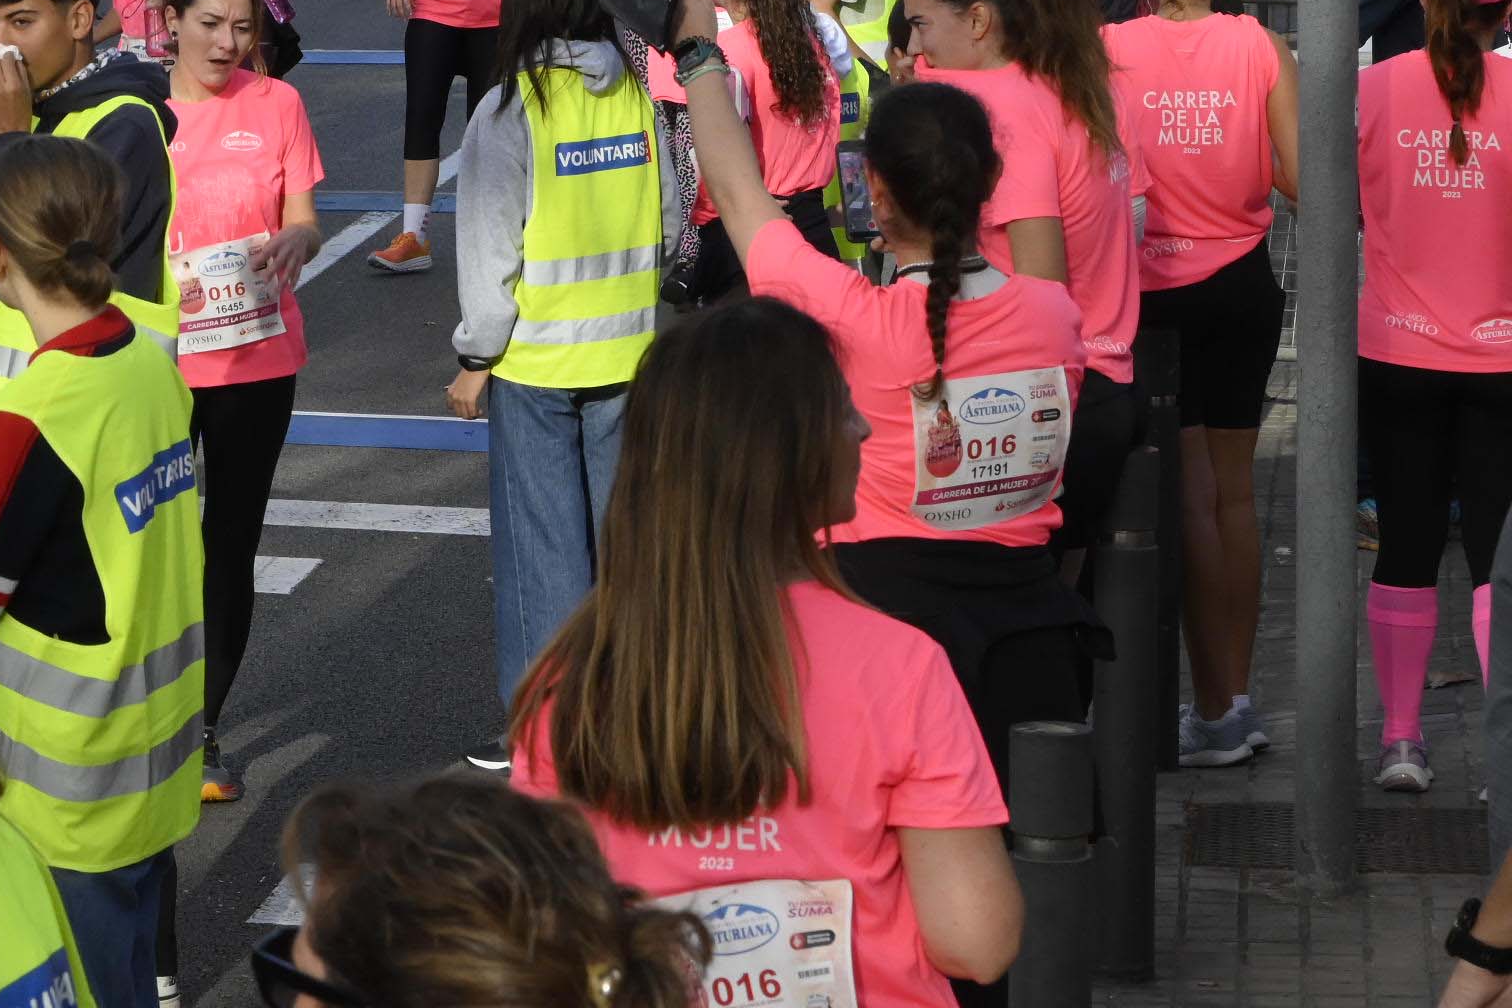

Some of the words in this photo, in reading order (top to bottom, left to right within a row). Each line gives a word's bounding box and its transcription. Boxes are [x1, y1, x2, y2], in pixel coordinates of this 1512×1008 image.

[1143, 90, 1237, 109] CARRERA
[1162, 109, 1186, 126] DE
[1196, 110, 1220, 127] LA
[1158, 128, 1224, 145] MUJER
[558, 141, 645, 167] VOLUNTARIS
[1183, 147, 1201, 155] 2023
[1418, 150, 1445, 168] DE
[1459, 152, 1481, 168] A
[1413, 169, 1485, 189] MUJER
[203, 260, 244, 274] ASTURIANA
[209, 282, 245, 301] 016
[215, 302, 244, 314] 16455
[187, 320, 219, 330] CARRERA
[239, 312, 258, 321] MUJER
[1385, 315, 1438, 335] OYSHO
[187, 334, 222, 345] OYSHO
[1030, 389, 1057, 400] SUMA
[964, 402, 1020, 419] ASTURIANA
[967, 434, 1017, 460] 016
[971, 462, 1008, 478] 17191
[932, 487, 972, 501] CARRERA
[973, 485, 985, 494] DE
[987, 484, 997, 492] LA
[999, 479, 1029, 491] MUJER
[924, 508, 971, 522] OYSHO
[698, 857, 734, 870] 2023
[788, 906, 833, 918] SUMA
[712, 969, 782, 1006] 016
